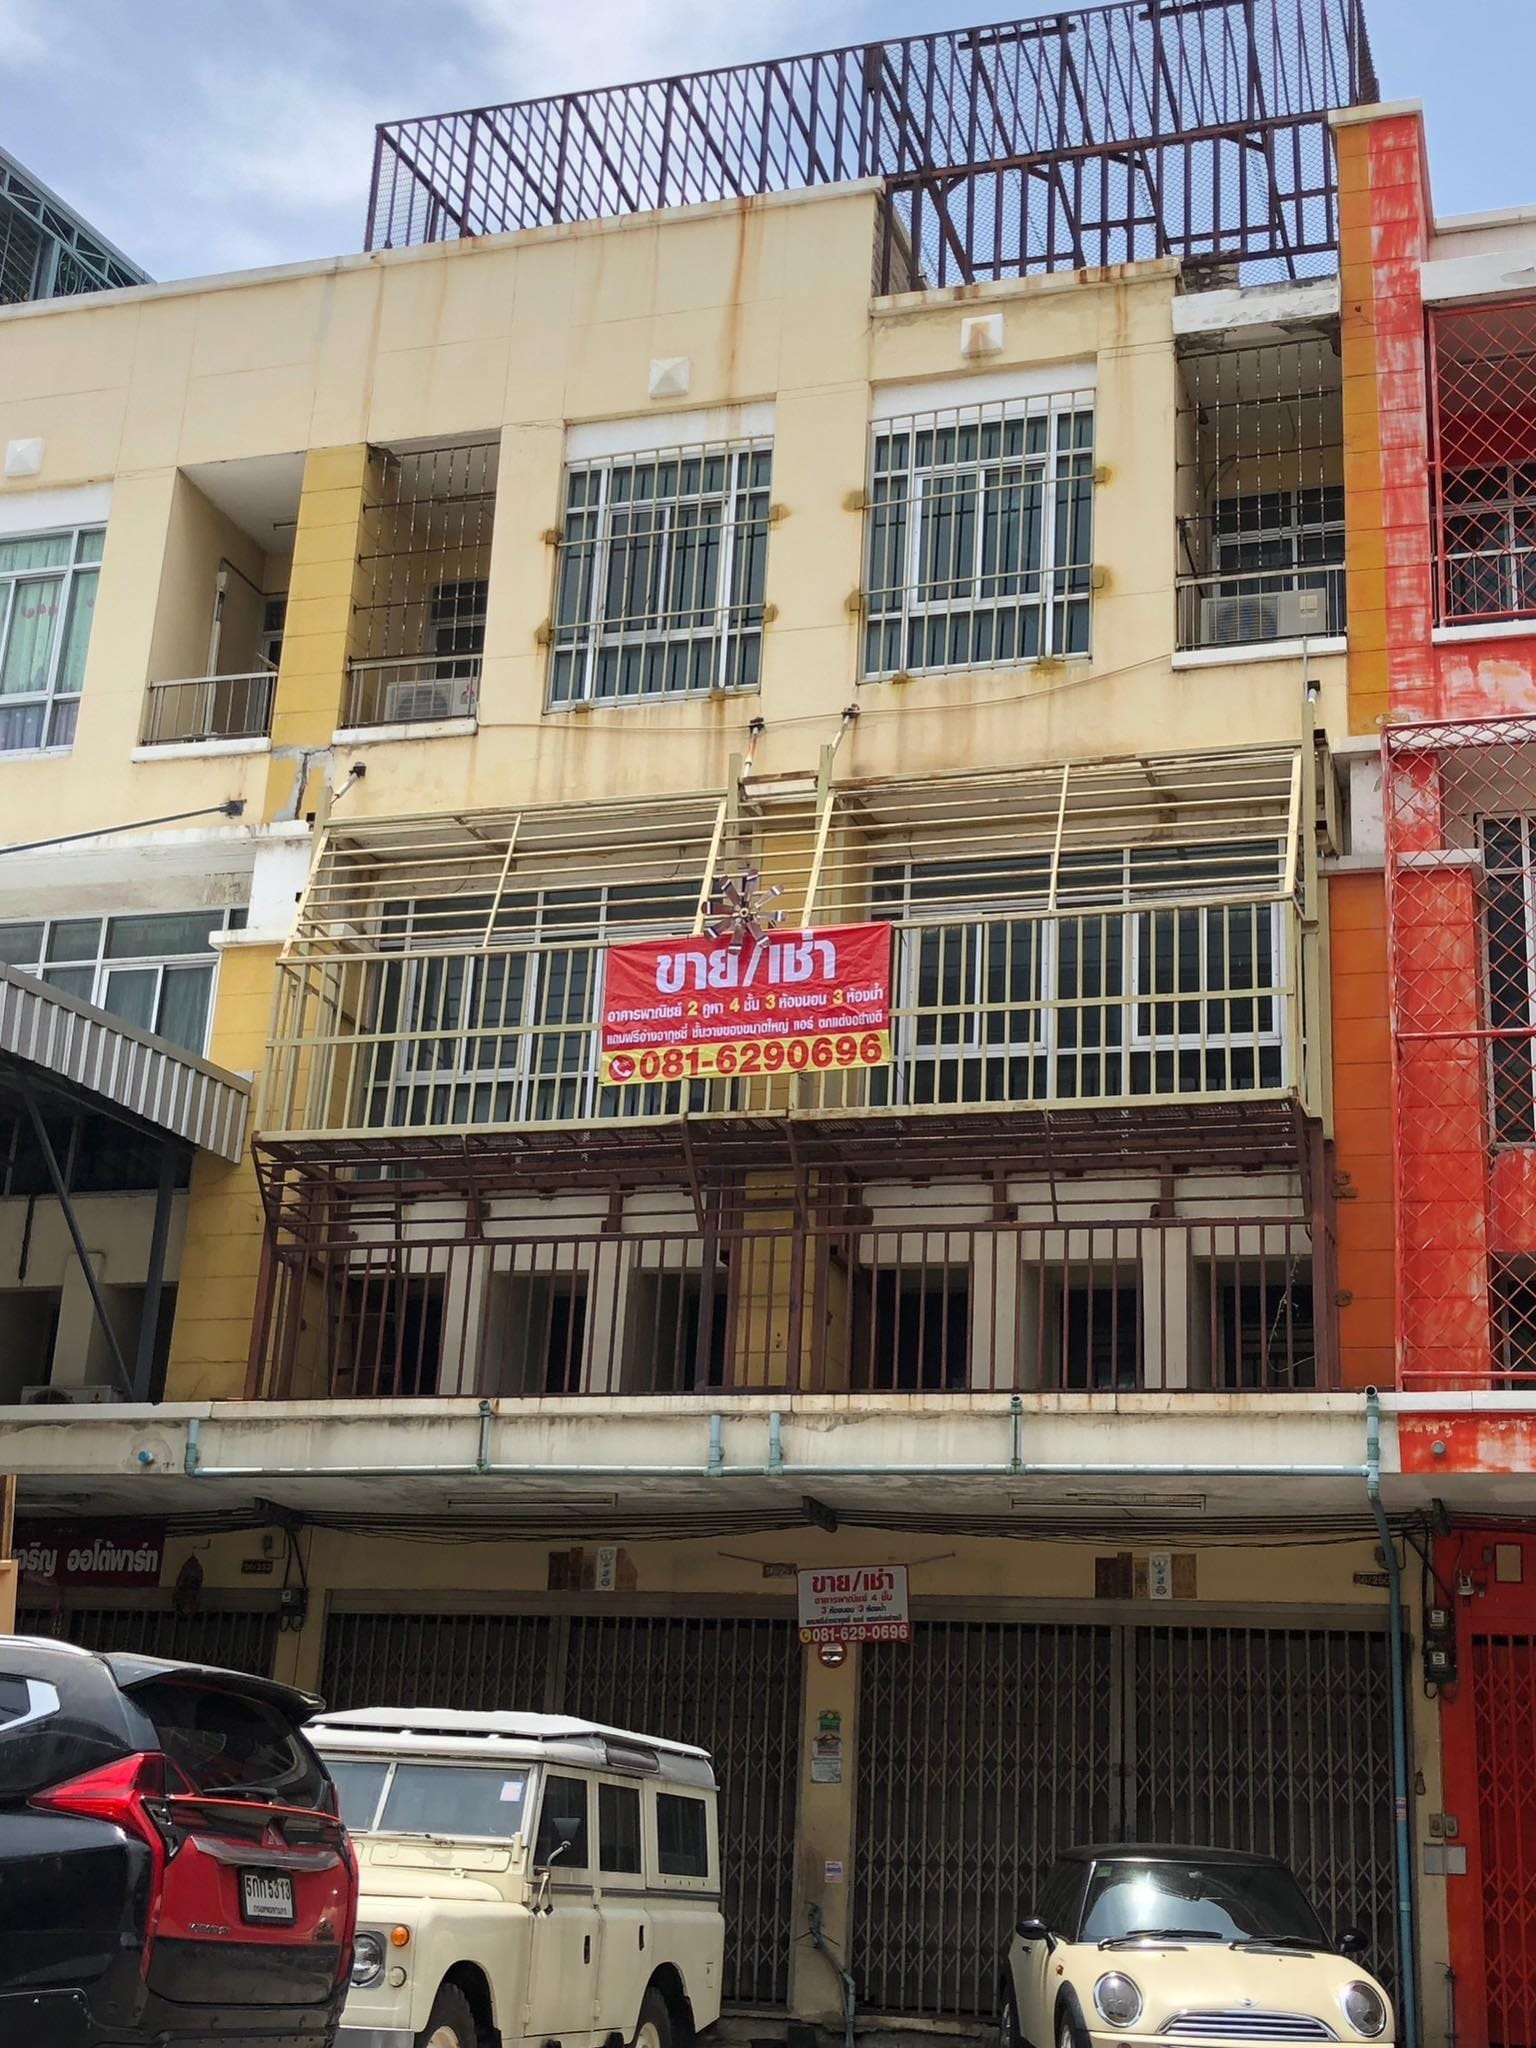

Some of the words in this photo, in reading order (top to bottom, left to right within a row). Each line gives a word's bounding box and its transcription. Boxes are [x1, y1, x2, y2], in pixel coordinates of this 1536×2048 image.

[655, 929, 837, 994] ขาย/เช่า
[607, 1002, 682, 1022] อาคารพาณิชย์
[687, 1001, 698, 1017] 2
[702, 1003, 724, 1018] คูหา
[729, 997, 740, 1012] 4
[743, 993, 760, 1012] ชั้น
[765, 994, 776, 1010] 3
[779, 993, 827, 1009] ห้องนอน
[832, 989, 844, 1005] 3
[846, 983, 883, 1004] ห้องน้ำ
[793, 1015, 814, 1031] แอร์
[638, 1032, 883, 1081] 081-6290696
[67, 1539, 159, 1573] ออโต้พาร์ท
[812, 1568, 894, 1593] ขาย/เช่า
[812, 1624, 908, 1642] 081-629-0696
